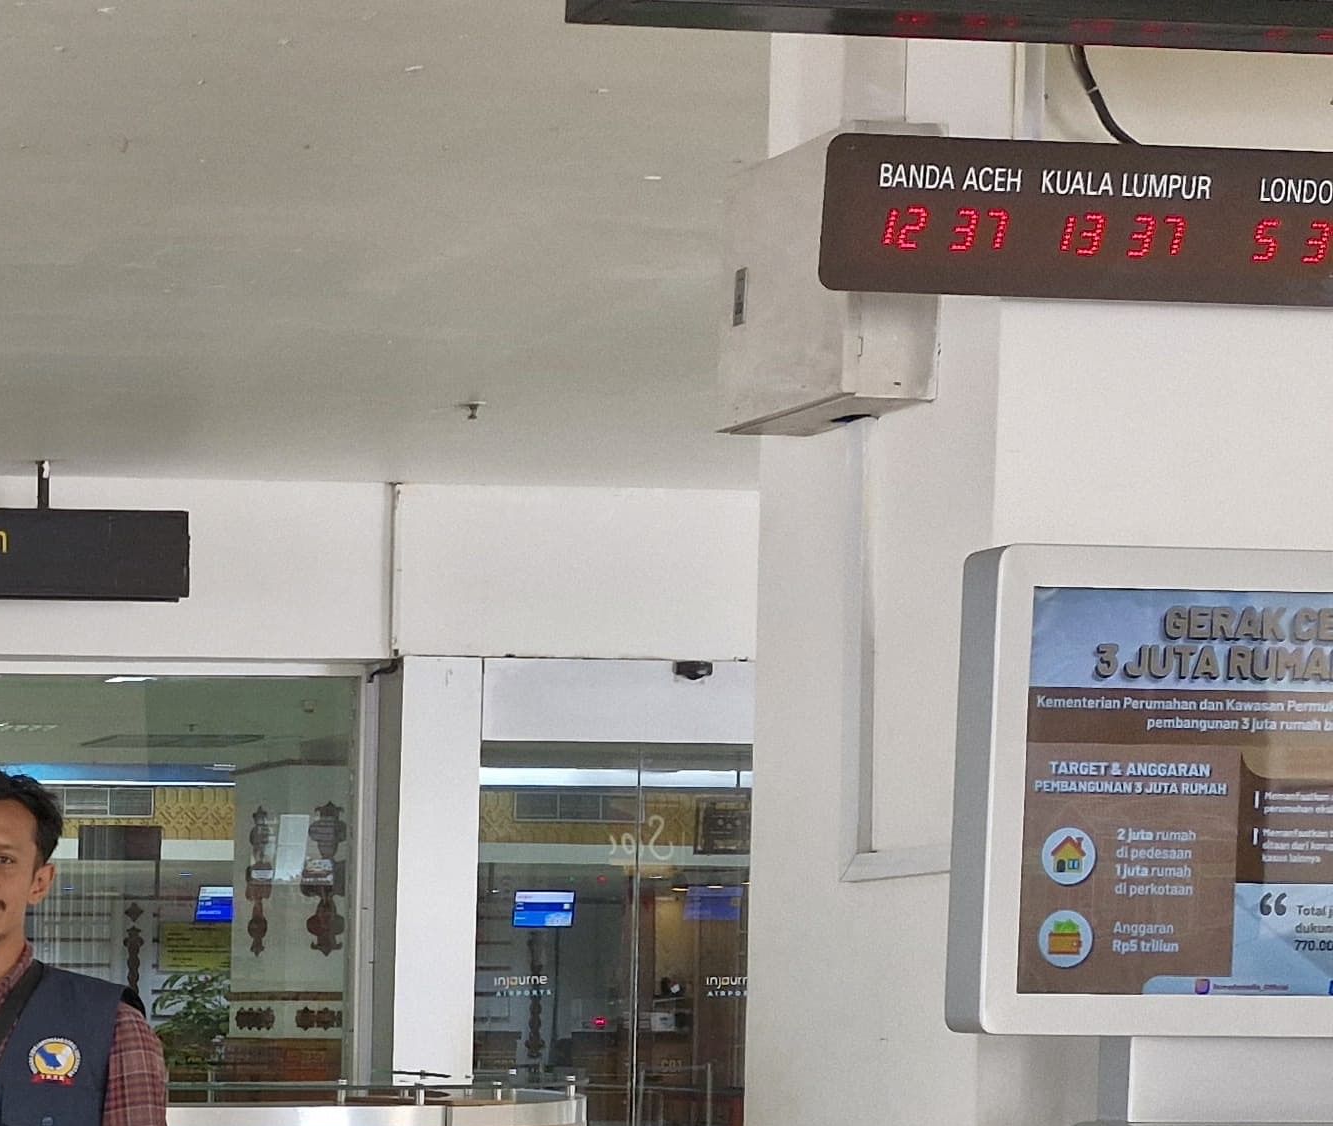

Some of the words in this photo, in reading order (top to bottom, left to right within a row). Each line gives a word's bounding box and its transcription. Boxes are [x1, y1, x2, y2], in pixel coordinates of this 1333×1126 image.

[879, 163, 955, 191] BANDA
[962, 166, 1023, 193] ACEH
[1041, 169, 1114, 197] KUALA
[1122, 172, 1212, 200] LUMPUR
[882, 205, 929, 252] 12
[949, 207, 1010, 252] 37
[1059, 213, 1108, 258] 13
[1126, 214, 1187, 259] 37
[1252, 218, 1282, 264] 5
[1163, 605, 1287, 641] GERAK
[1095, 643, 1120, 679] 3
[1123, 645, 1221, 681] JUTA
[1225, 645, 1333, 682] RUMA
[1037, 695, 1121, 709] Kementerian
[1123, 697, 1198, 711] Perumahan
[1199, 698, 1223, 711] dan
[1225, 700, 1285, 713] Kawasan
[1146, 716, 1239, 734] pembangunan
[1241, 717, 1250, 730] 3
[1251, 718, 1277, 733] juta
[1279, 719, 1321, 732] rumah
[1049, 761, 1110, 777] TARGET
[1111, 763, 1123, 776] &
[1126, 763, 1211, 778] ANGGARAN
[1034, 780, 1133, 794] PEMBANGUNAN
[1134, 782, 1143, 794] 3
[1144, 782, 1179, 795] JUTA
[1181, 782, 1229, 796] RUMAH
[1117, 828, 1126, 841] 2
[1127, 828, 1154, 844] juta
[1155, 829, 1196, 842] rumah
[1116, 847, 1128, 859] di
[1130, 848, 1193, 862] pedesaan
[1150, 865, 1191, 878] rumah
[1114, 883, 1127, 894] di
[1129, 883, 1194, 897] perkotaan
[1296, 905, 1327, 916] Total
[1113, 921, 1174, 936] Anggaran
[1112, 940, 1137, 954] Rp5
[1140, 940, 1179, 953] triliun
